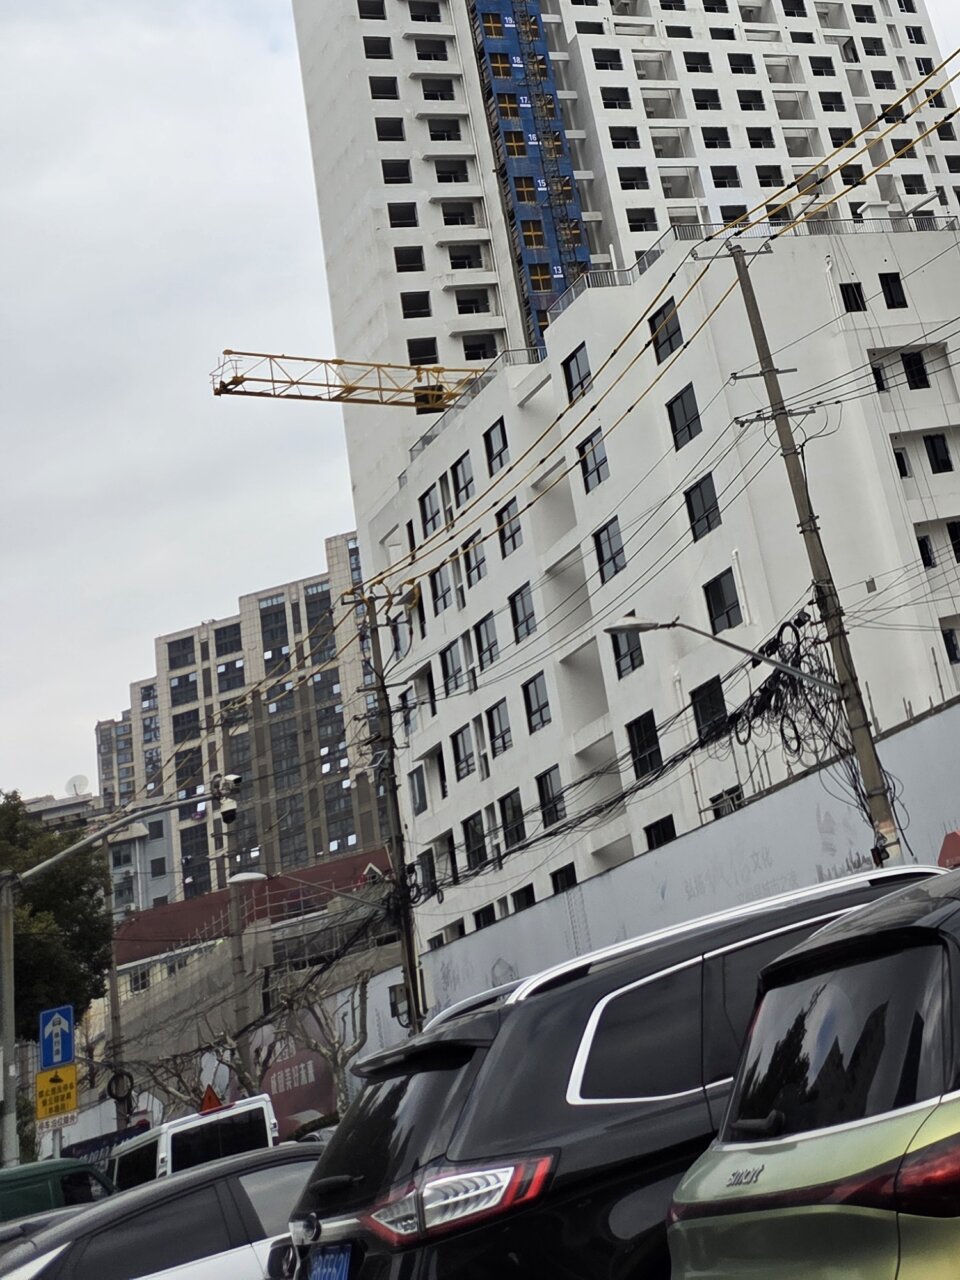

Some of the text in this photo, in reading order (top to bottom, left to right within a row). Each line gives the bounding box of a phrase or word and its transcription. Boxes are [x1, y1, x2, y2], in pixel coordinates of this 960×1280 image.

[528, 133, 537, 141] 16
[537, 179, 546, 187] 15
[553, 266, 562, 274] 13
